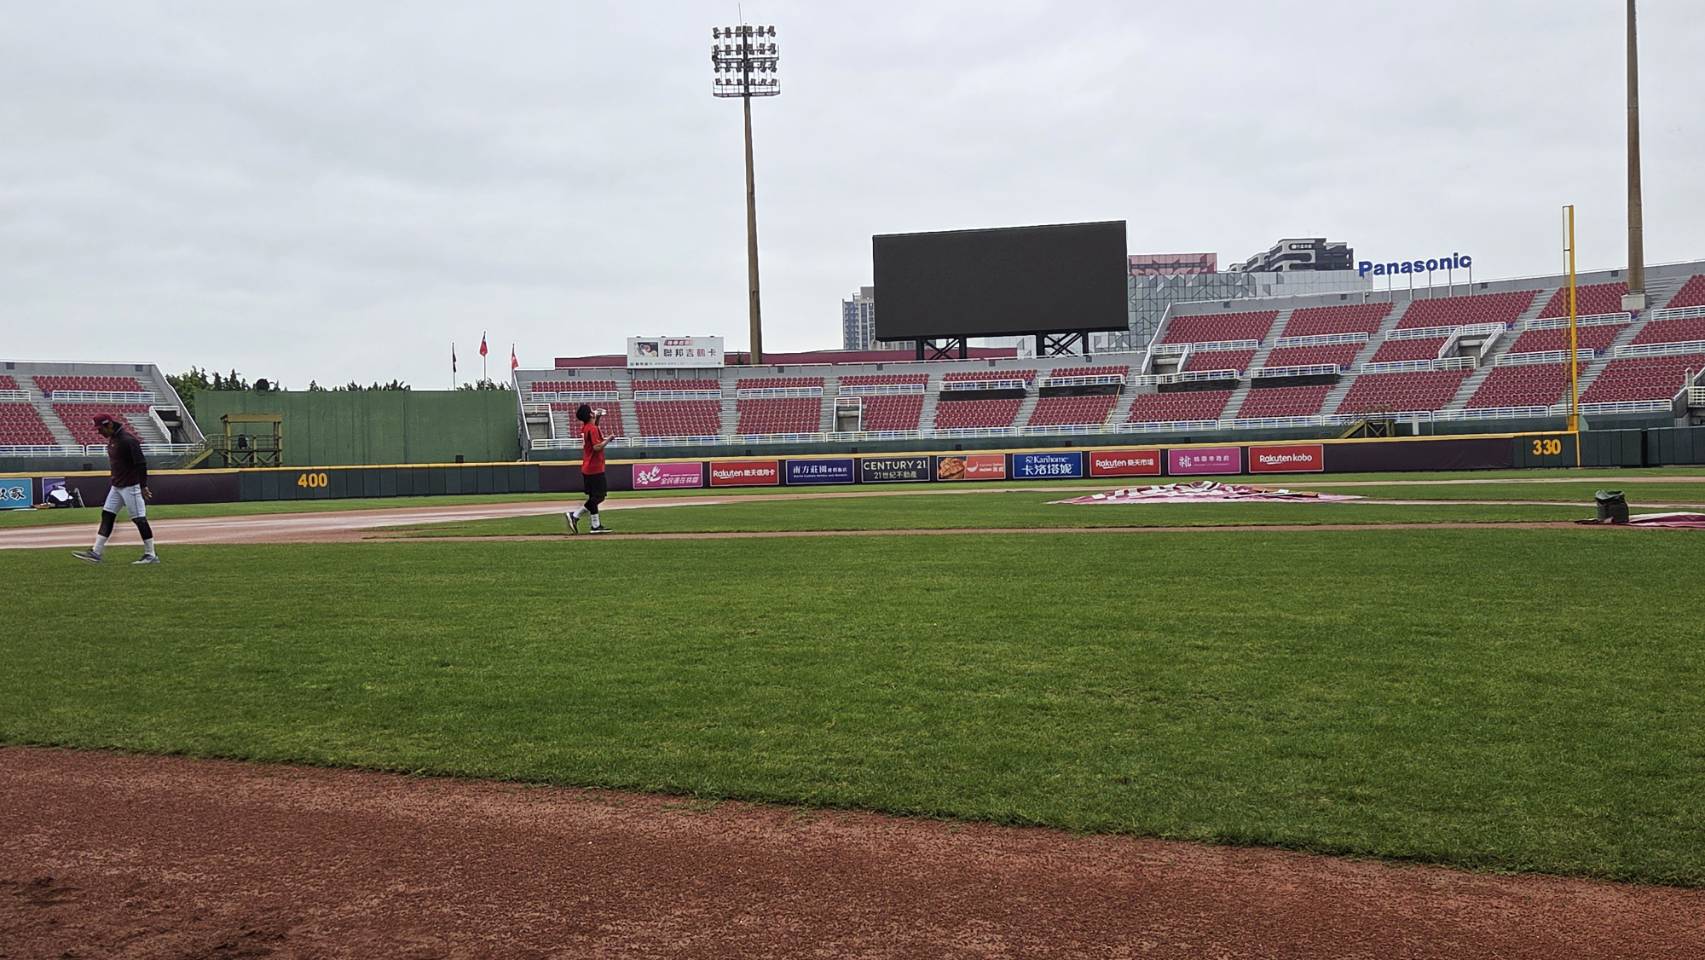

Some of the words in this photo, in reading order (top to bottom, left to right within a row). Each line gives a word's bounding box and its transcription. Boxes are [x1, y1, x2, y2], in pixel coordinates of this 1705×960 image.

[1358, 252, 1472, 278] Panasonic
[1532, 439, 1562, 455] 330
[1095, 459, 1126, 469] Rakuten
[1259, 454, 1292, 464] Rakuten
[1293, 453, 1312, 462] kobo
[863, 461, 914, 470] CENTURY
[916, 460, 926, 469] 21
[712, 469, 743, 479] Rakuten
[297, 472, 328, 488] 400
